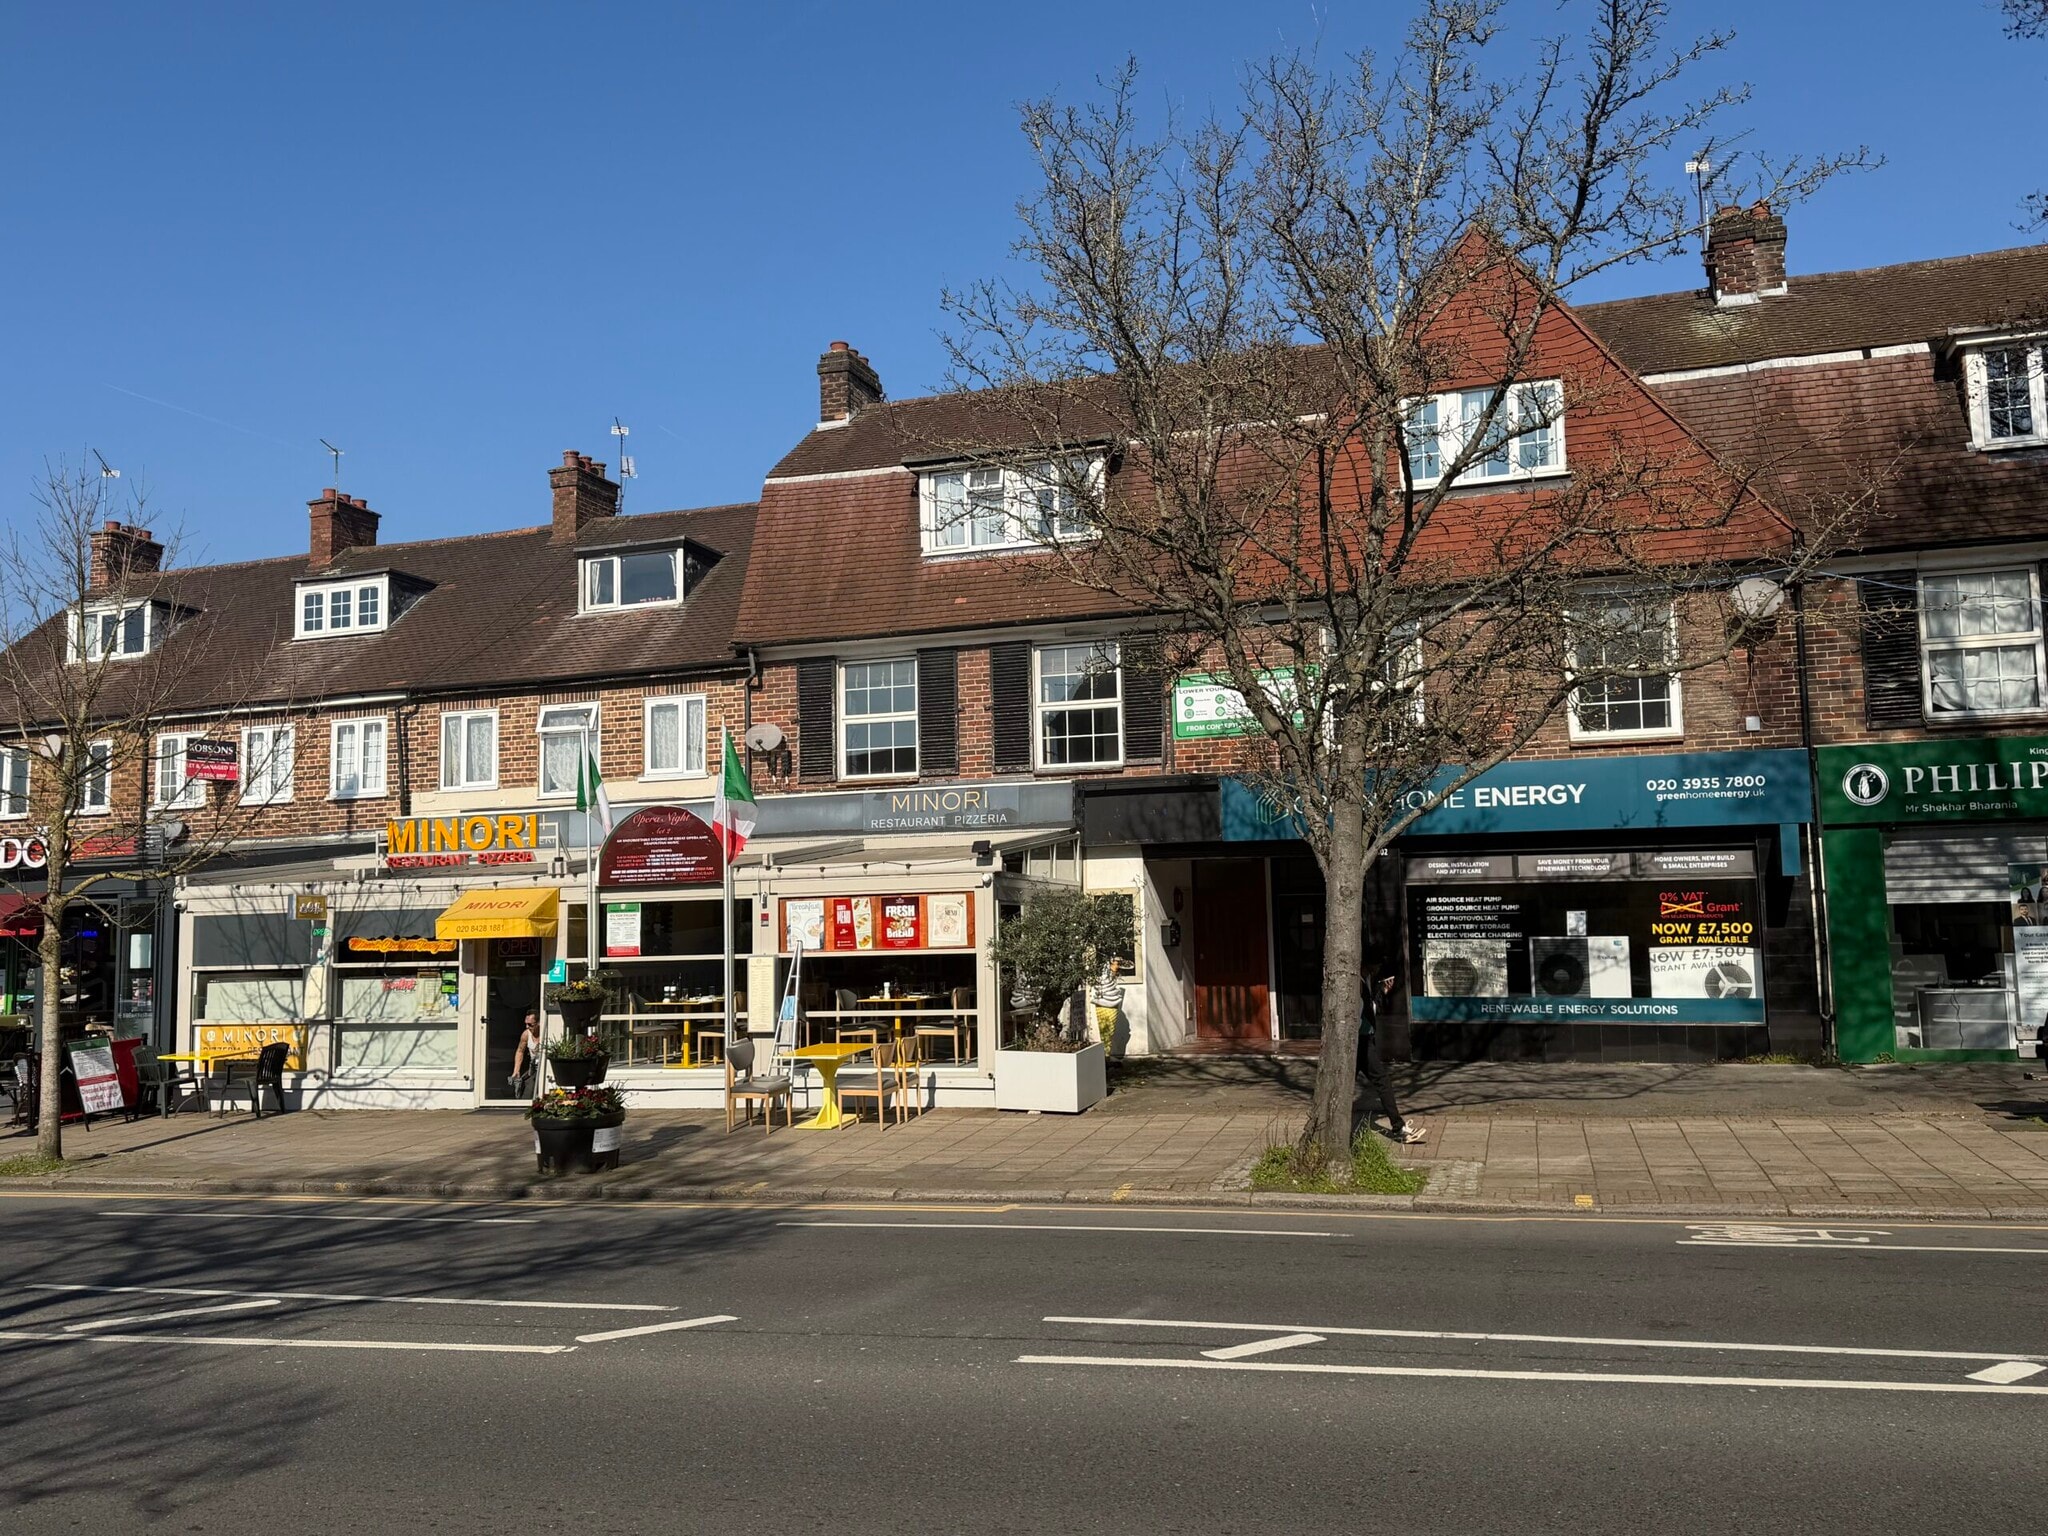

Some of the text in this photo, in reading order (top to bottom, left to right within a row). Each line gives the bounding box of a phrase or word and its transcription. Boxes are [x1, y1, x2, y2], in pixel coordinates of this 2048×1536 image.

[1178, 687, 1202, 695] LOWER
[1186, 724, 1205, 732] FROM
[1646, 775, 1766, 791] 020 3935 7800
[892, 790, 988, 813] MINORI
[1474, 783, 1586, 808] ENERGY
[1656, 788, 1765, 803] greenhomeenergy.uk
[1905, 804, 1919, 812] Mr
[1922, 802, 1966, 812] Shekhar
[633, 811, 690, 827] Opera Night
[871, 813, 1007, 829] RESTAURANT PIZZERIA
[387, 813, 538, 854] MINORI
[386, 850, 535, 868] RESTAURANT PIZZERIA
[1672, 855, 1700, 863] OWNERS,
[1659, 892, 1678, 901] 0%
[464, 900, 530, 910] MINORI
[885, 905, 915, 918] FRESH
[456, 924, 470, 933] 020
[1651, 921, 1753, 936] NOW £7,500
[500, 938, 539, 955] OPEN
[1659, 935, 1749, 944] GRANT AVAILABLE
[1481, 1004, 1679, 1015] RENEWABLE ENERGY SOLUTIONS
[223, 1028, 286, 1042] MINORI
